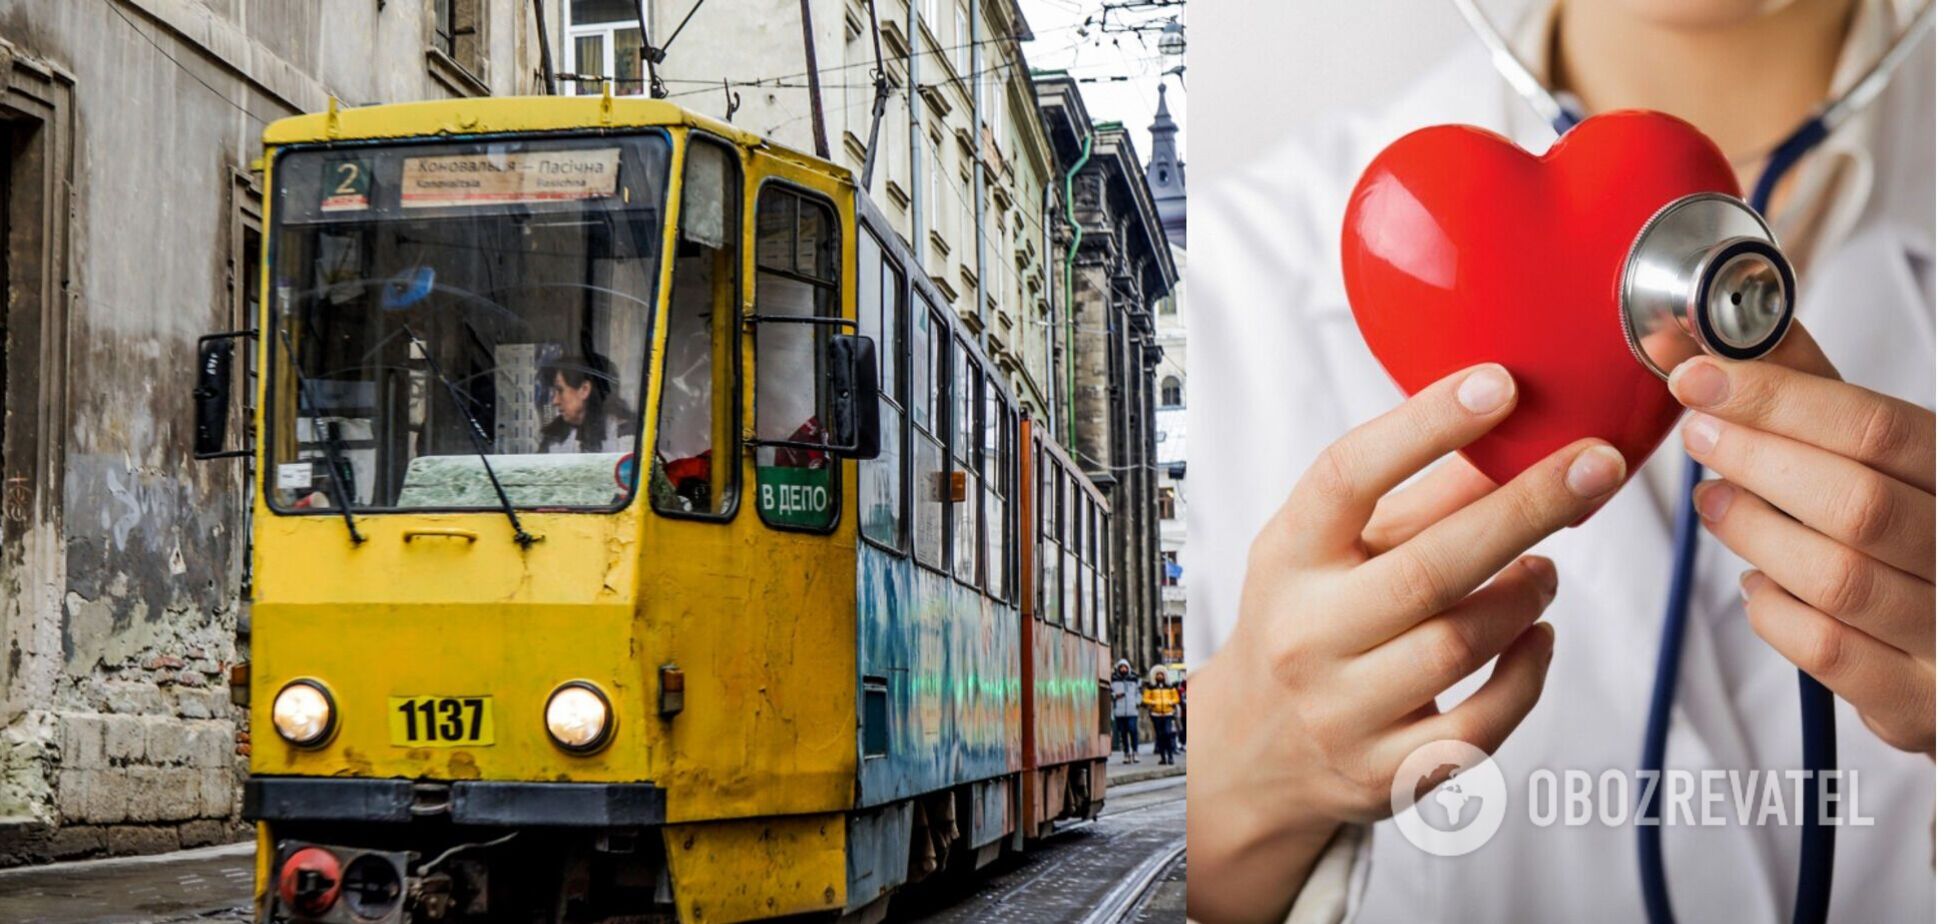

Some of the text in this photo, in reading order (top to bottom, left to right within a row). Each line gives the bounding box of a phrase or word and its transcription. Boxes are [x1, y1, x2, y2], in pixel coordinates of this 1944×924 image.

[336, 163, 358, 194] 2
[539, 159, 605, 174] Пасічна
[761, 483, 827, 516] В ДЕПО
[398, 698, 484, 742] 1137
